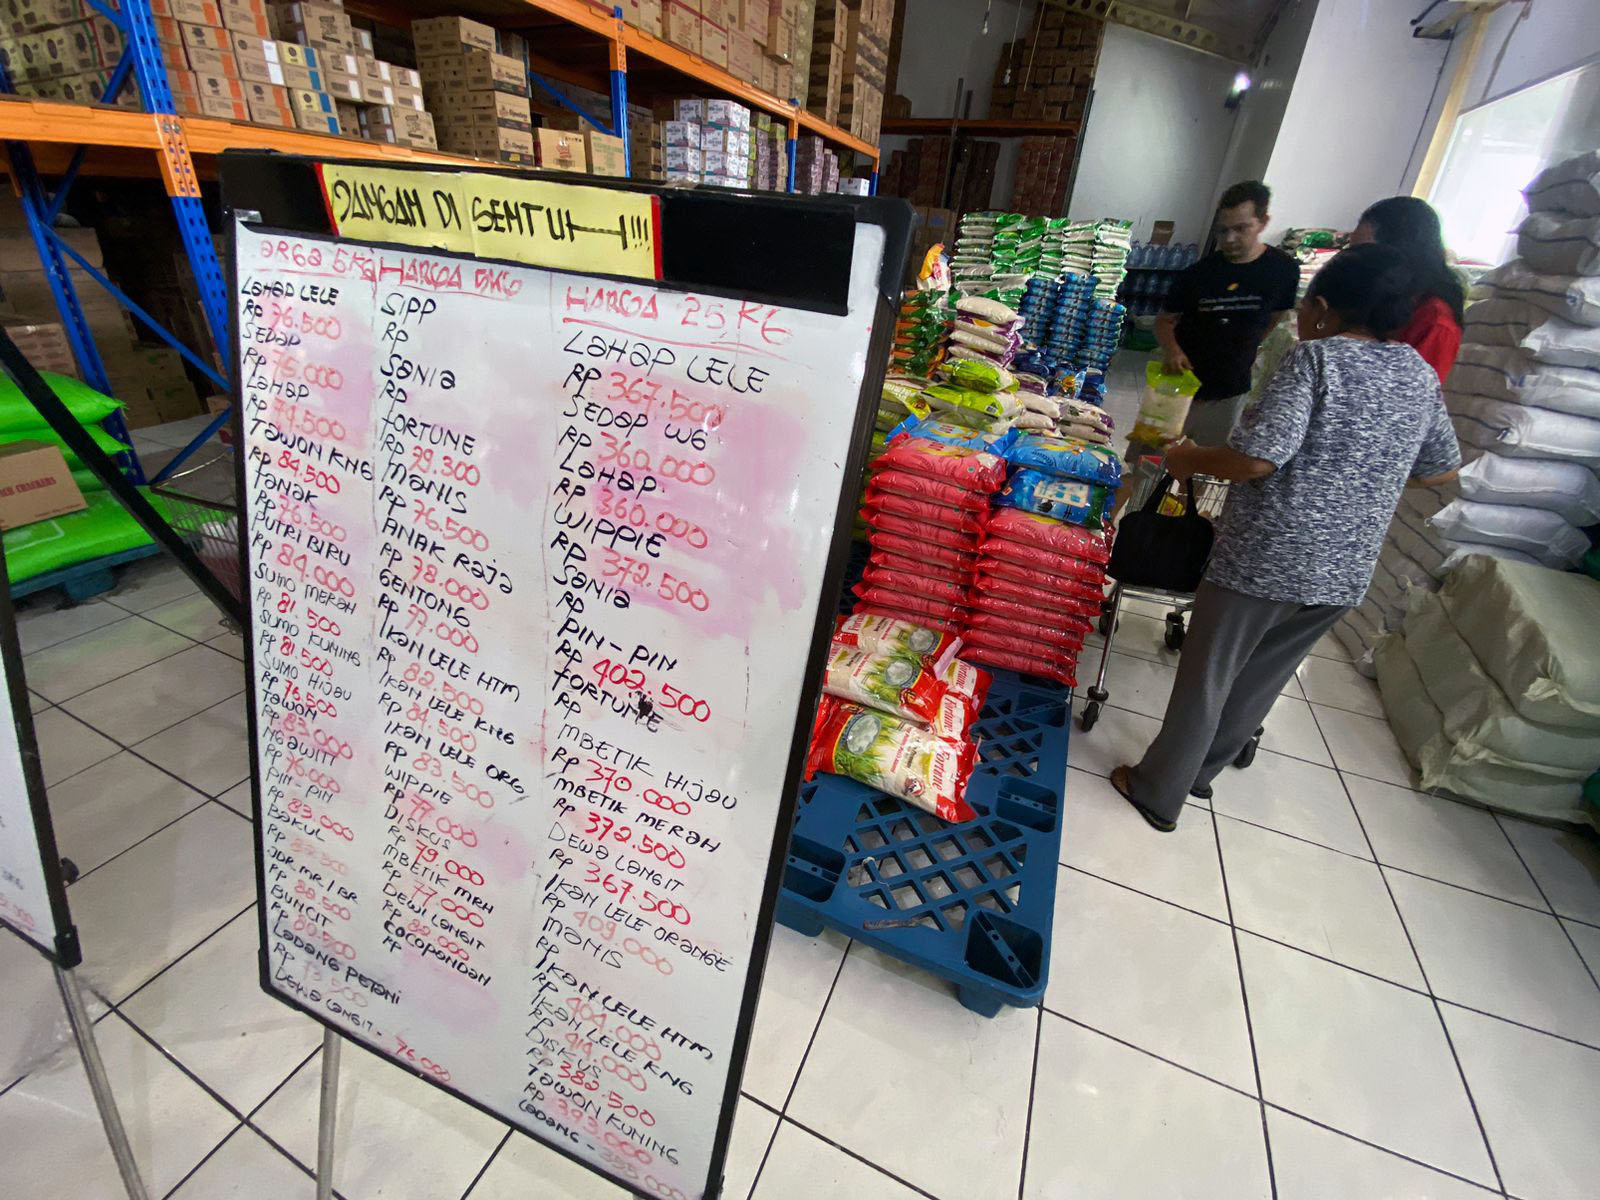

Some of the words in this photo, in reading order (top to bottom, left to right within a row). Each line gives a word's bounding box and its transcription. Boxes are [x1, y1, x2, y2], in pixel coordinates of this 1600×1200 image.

[334, 180, 427, 228] JANGAN
[433, 190, 463, 231] DI
[300, 285, 339, 306] LELE
[566, 286, 659, 319] HARGA
[682, 296, 726, 330] 25
[686, 355, 771, 394] LELE
[277, 450, 340, 494] 84.500
[598, 431, 716, 486] 360.000
[251, 510, 302, 543] PUTRI
[306, 535, 351, 567] BIRU
[382, 517, 446, 564] ANAK
[413, 499, 490, 553] 76.500
[554, 502, 667, 558] WIPPIE
[596, 487, 709, 549] 360.000
[379, 568, 470, 628] GENTONG
[412, 555, 490, 611] 78.000
[601, 545, 710, 612] 372.500
[308, 631, 361, 667] KUNING
[429, 648, 472, 681] LELE
[477, 671, 520, 703] HTM
[428, 695, 465, 721] LELE
[593, 658, 711, 723] 402.500
[439, 742, 477, 769] LELE
[557, 723, 654, 777] MBETIK
[384, 764, 453, 805] WIPPIE
[553, 777, 628, 815] MBETIK
[585, 758, 692, 816] 370.000
[384, 803, 452, 850] DISKUS
[584, 811, 686, 869] 372.500
[415, 839, 485, 886] 79.000
[270, 884, 333, 927] BUNCIT
[584, 861, 691, 926] 367.500
[604, 902, 653, 932] LELE
[602, 995, 657, 1031] LELE
[660, 1026, 715, 1061] HTM
[586, 1027, 637, 1063] LELE
[643, 1060, 694, 1096] KNG
[606, 1113, 680, 1166] KUNING
